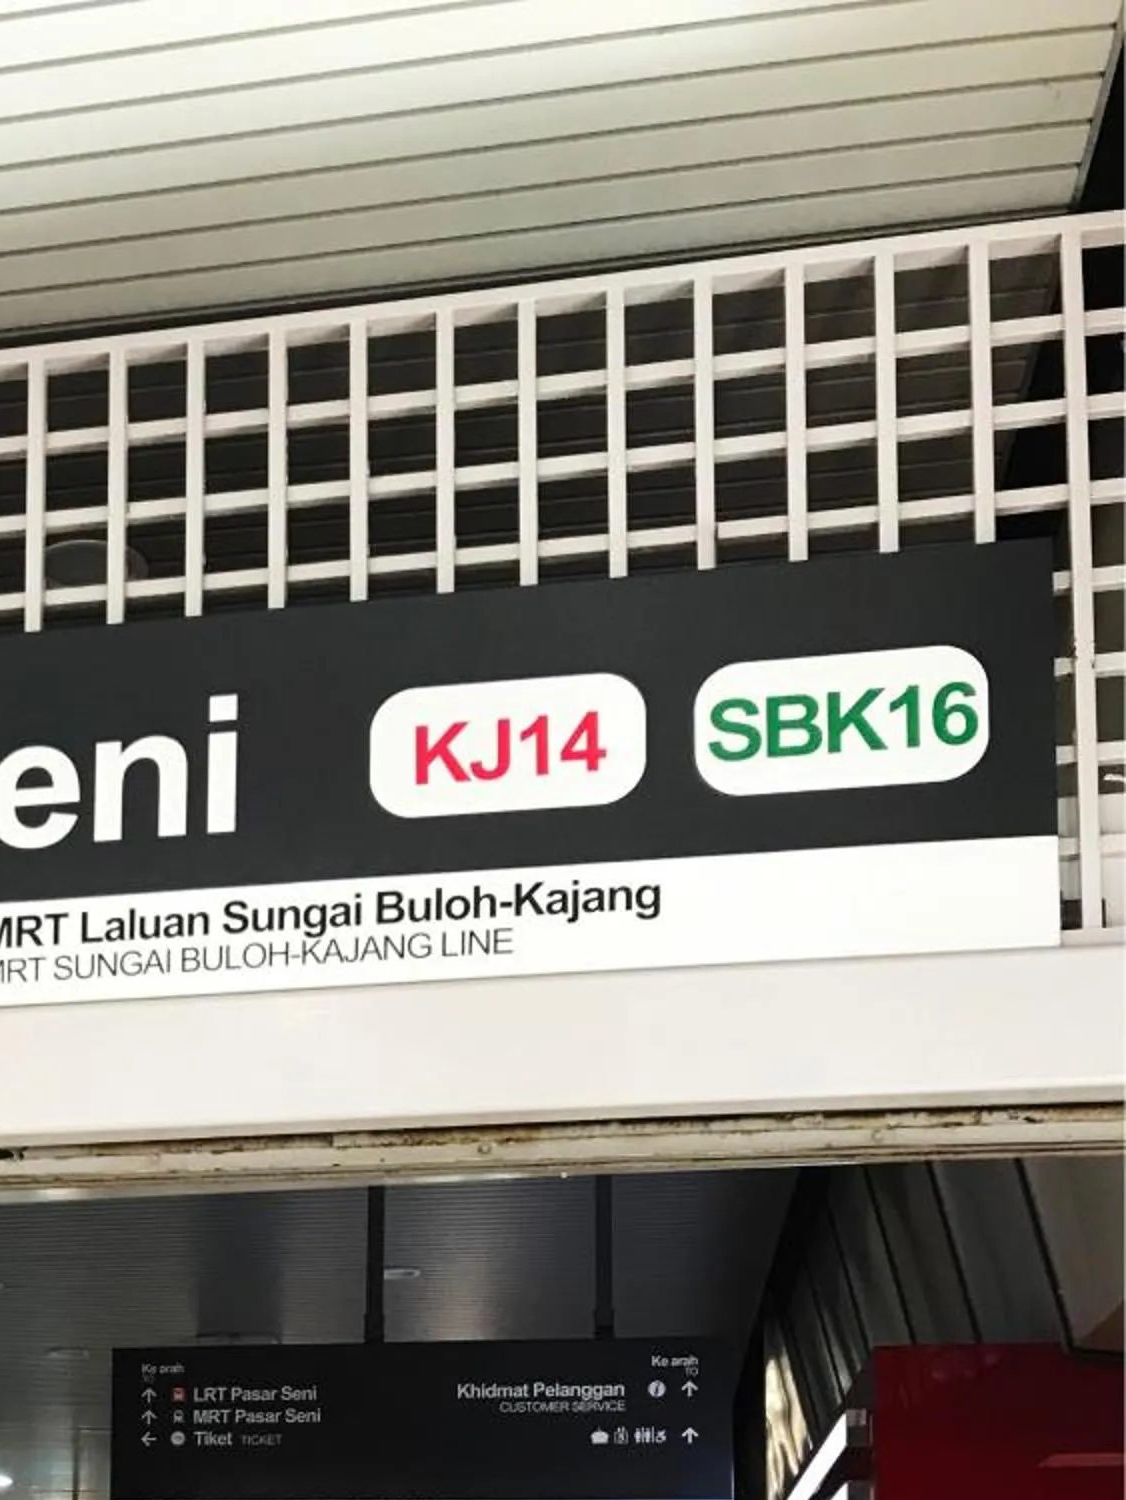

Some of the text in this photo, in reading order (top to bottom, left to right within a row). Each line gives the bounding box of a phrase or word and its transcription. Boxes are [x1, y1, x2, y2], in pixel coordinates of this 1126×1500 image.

[708, 681, 979, 761] SBK16
[414, 711, 607, 785] KJ14
[80, 906, 210, 944] Laluan
[222, 894, 363, 939] Sungai
[376, 881, 662, 924] Buloh-Kajang
[53, 950, 173, 981] SUNGAI
[181, 933, 433, 974] BULOH-KAJANG
[441, 928, 515, 955] LINE
[193, 1385, 317, 1402] LRT Pasar Seni
[457, 1381, 625, 1400] Khidmat Pelanggan
[193, 1408, 321, 1424] MRT Pasar Seni
[499, 1400, 626, 1413] CUSTOMER SERVICE
[193, 1431, 233, 1446] Tiket
